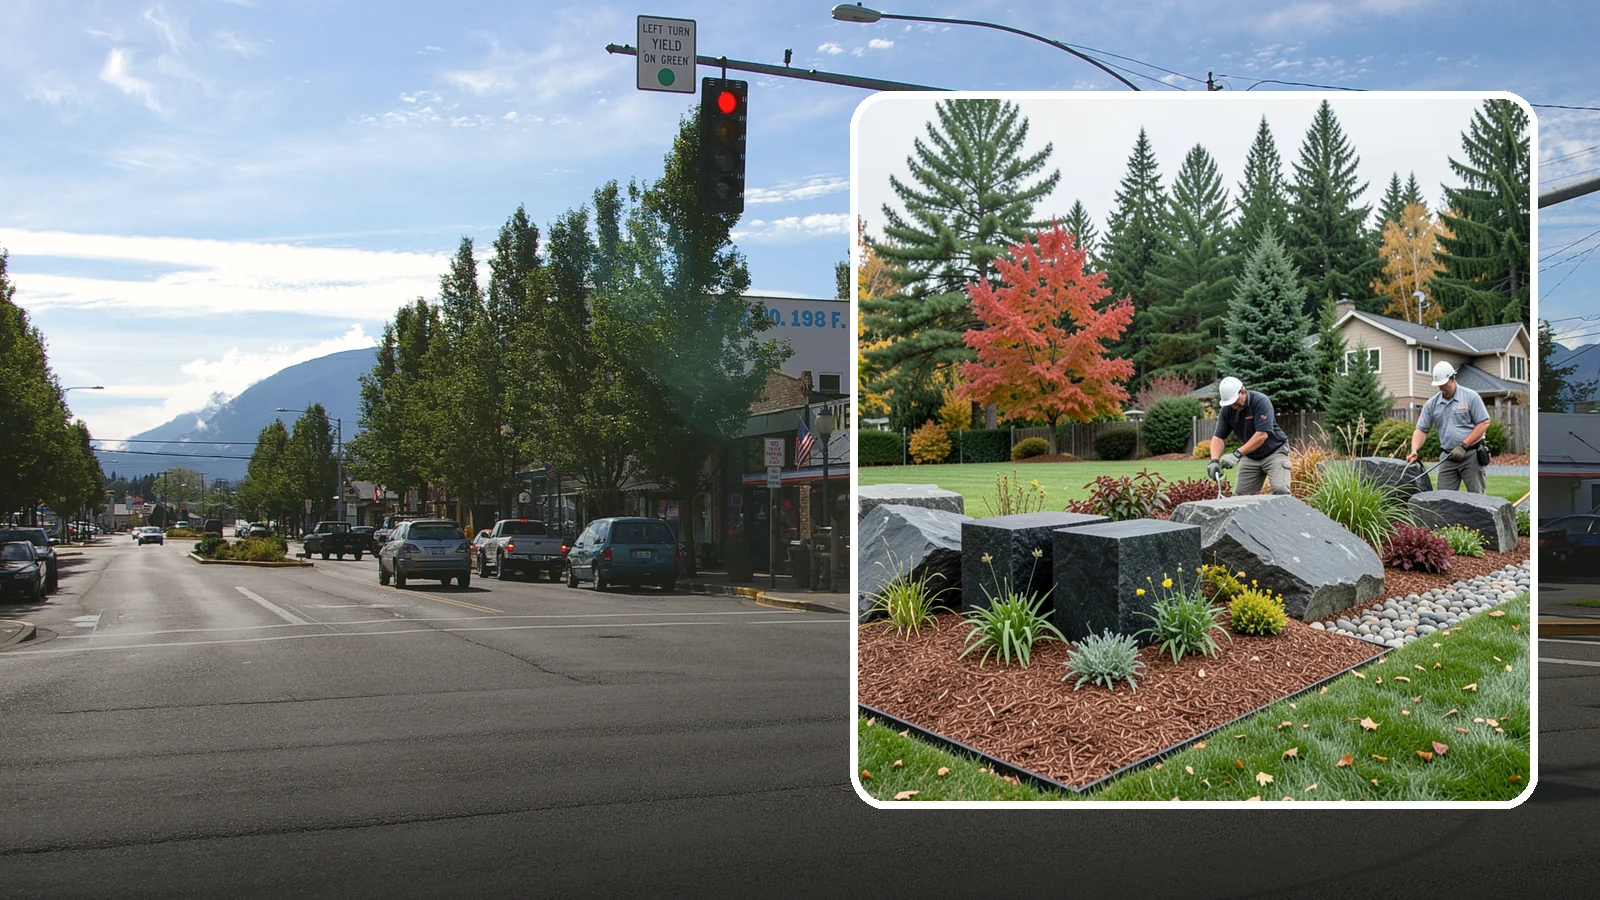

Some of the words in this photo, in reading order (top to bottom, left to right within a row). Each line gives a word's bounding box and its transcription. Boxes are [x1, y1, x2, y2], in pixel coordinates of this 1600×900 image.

[643, 24, 662, 34] LEFT
[668, 26, 690, 36] TURN
[652, 38, 682, 51] YIELD
[644, 53, 656, 63] ON
[661, 55, 688, 66] GREEN
[791, 310, 826, 328] 198
[831, 311, 846, 329] F.
